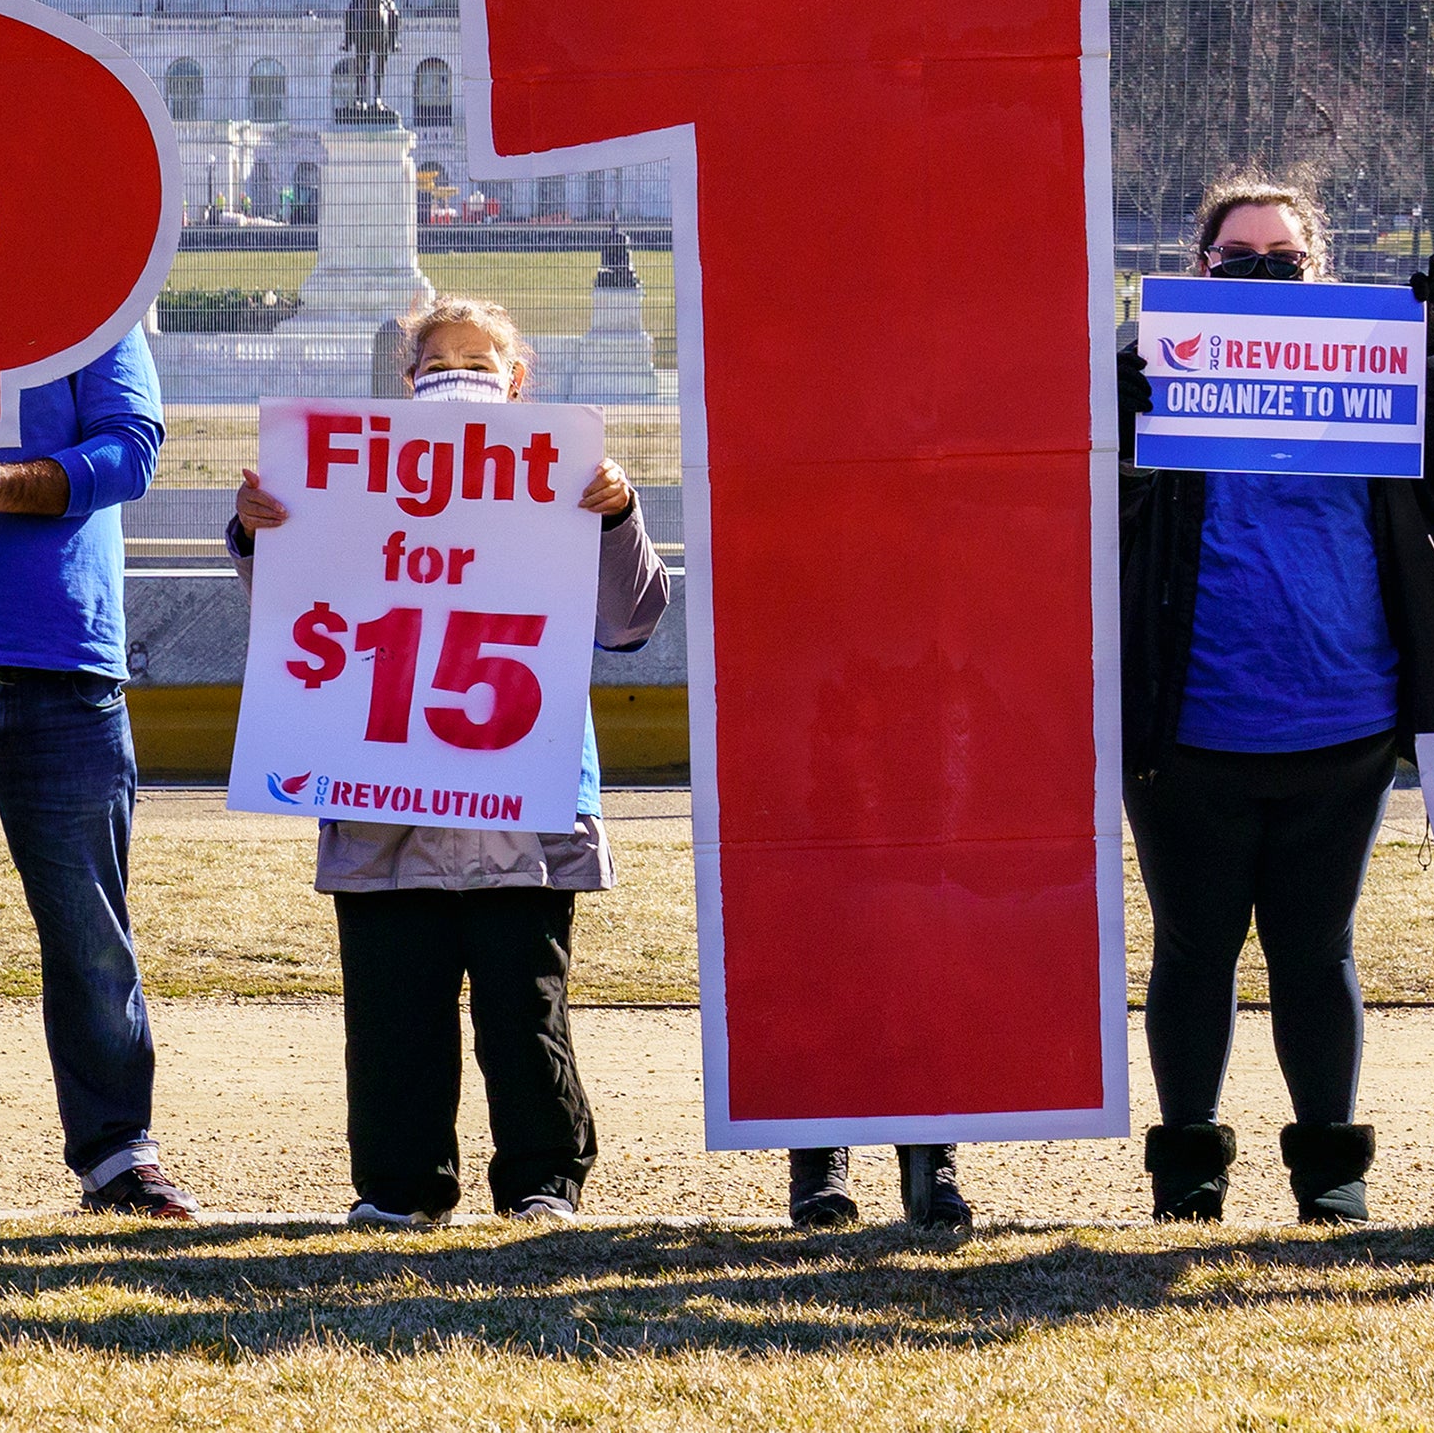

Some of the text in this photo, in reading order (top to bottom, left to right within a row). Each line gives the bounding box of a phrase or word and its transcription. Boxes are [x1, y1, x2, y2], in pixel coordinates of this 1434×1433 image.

[1209, 335, 1408, 374] OUR REVOLUTION
[1167, 381, 1392, 419] ORGANIZE TO WIN
[305, 413, 559, 517] Fight
[382, 530, 475, 585] for
[286, 601, 547, 750] $15
[314, 775, 522, 821] OUR REVOLUTION
